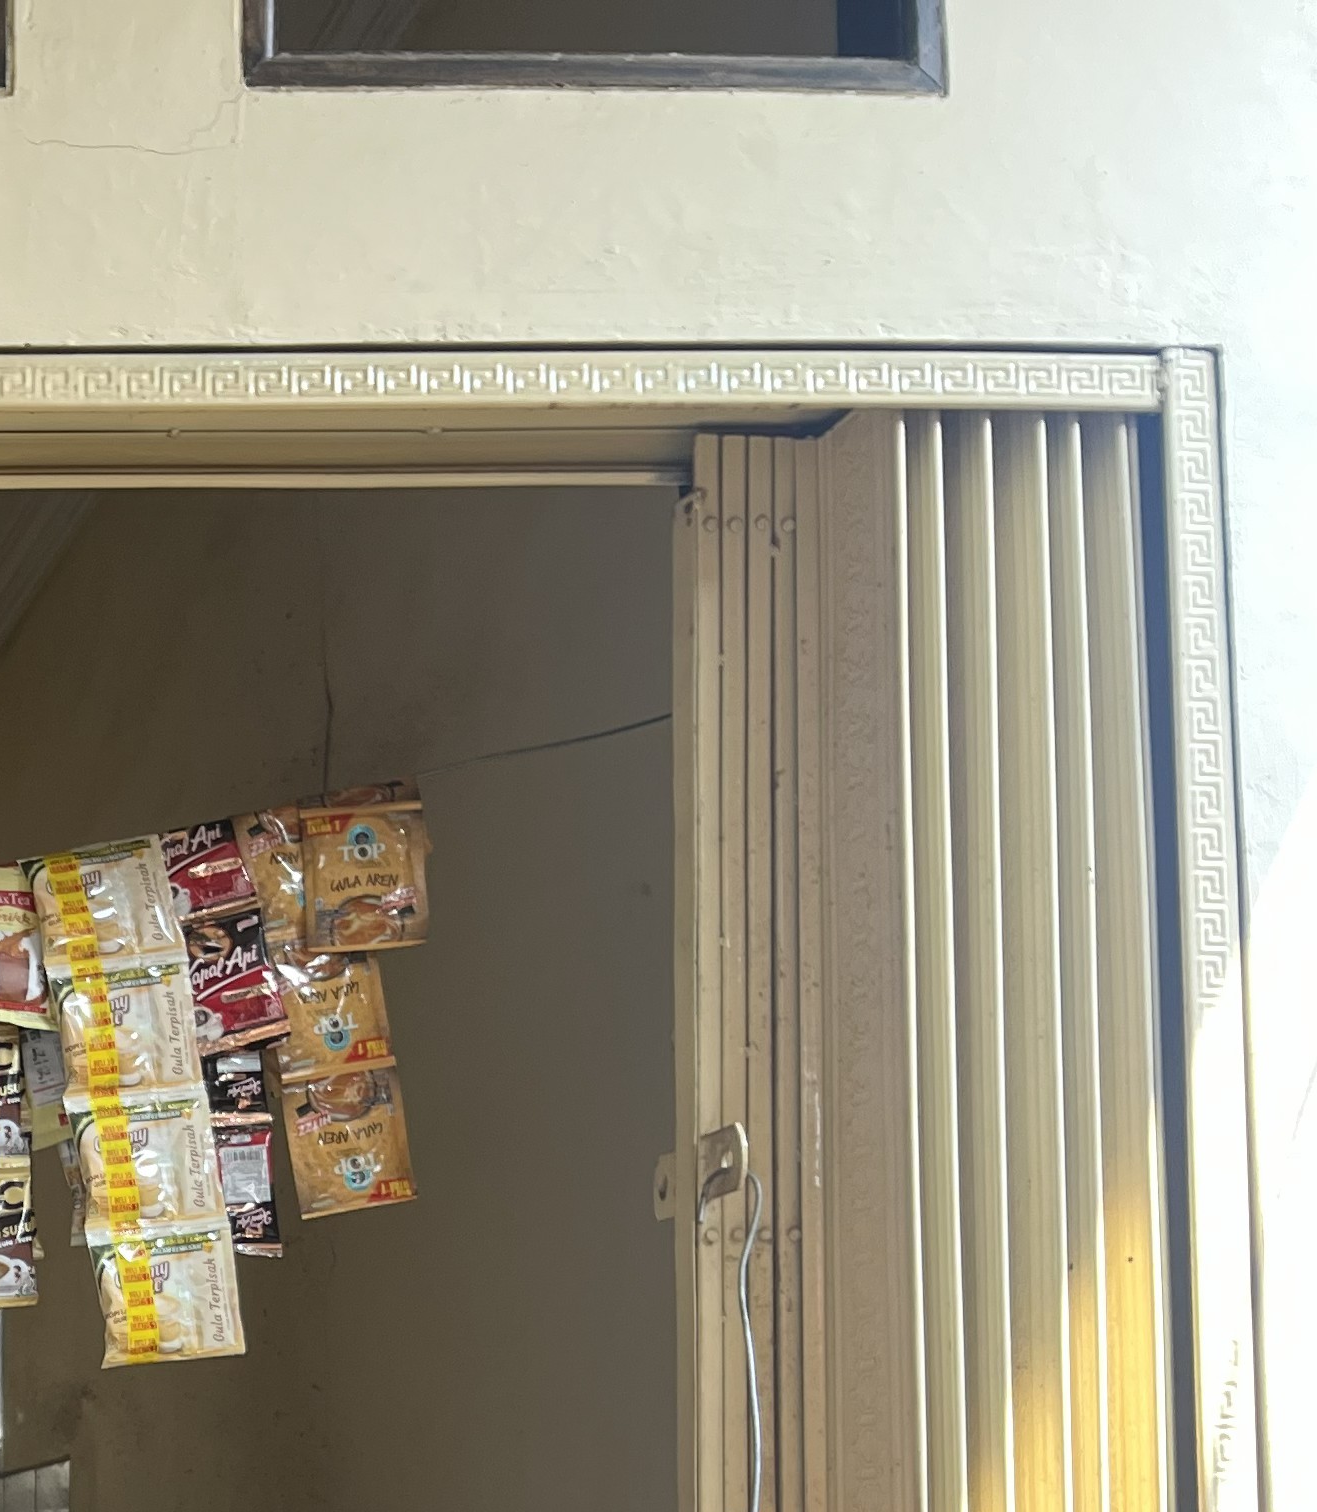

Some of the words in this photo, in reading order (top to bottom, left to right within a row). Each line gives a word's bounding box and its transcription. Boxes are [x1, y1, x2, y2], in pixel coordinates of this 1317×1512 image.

[191, 825, 223, 852] Api
[338, 843, 386, 862] TOP
[138, 862, 155, 911] Terpisah
[330, 877, 361, 892] GULA
[365, 874, 399, 887] AREN
[147, 912, 163, 940] Gula
[227, 945, 259, 970] Api
[165, 991, 181, 1043] Terpisah
[314, 1013, 359, 1034] TOP
[170, 1047, 183, 1076] Gula
[317, 1130, 350, 1145] AREN
[352, 1122, 383, 1142] GULA
[182, 1124, 201, 1176] Terpisah
[191, 1180, 205, 1207] Gula
[211, 1314, 225, 1342] Gula
